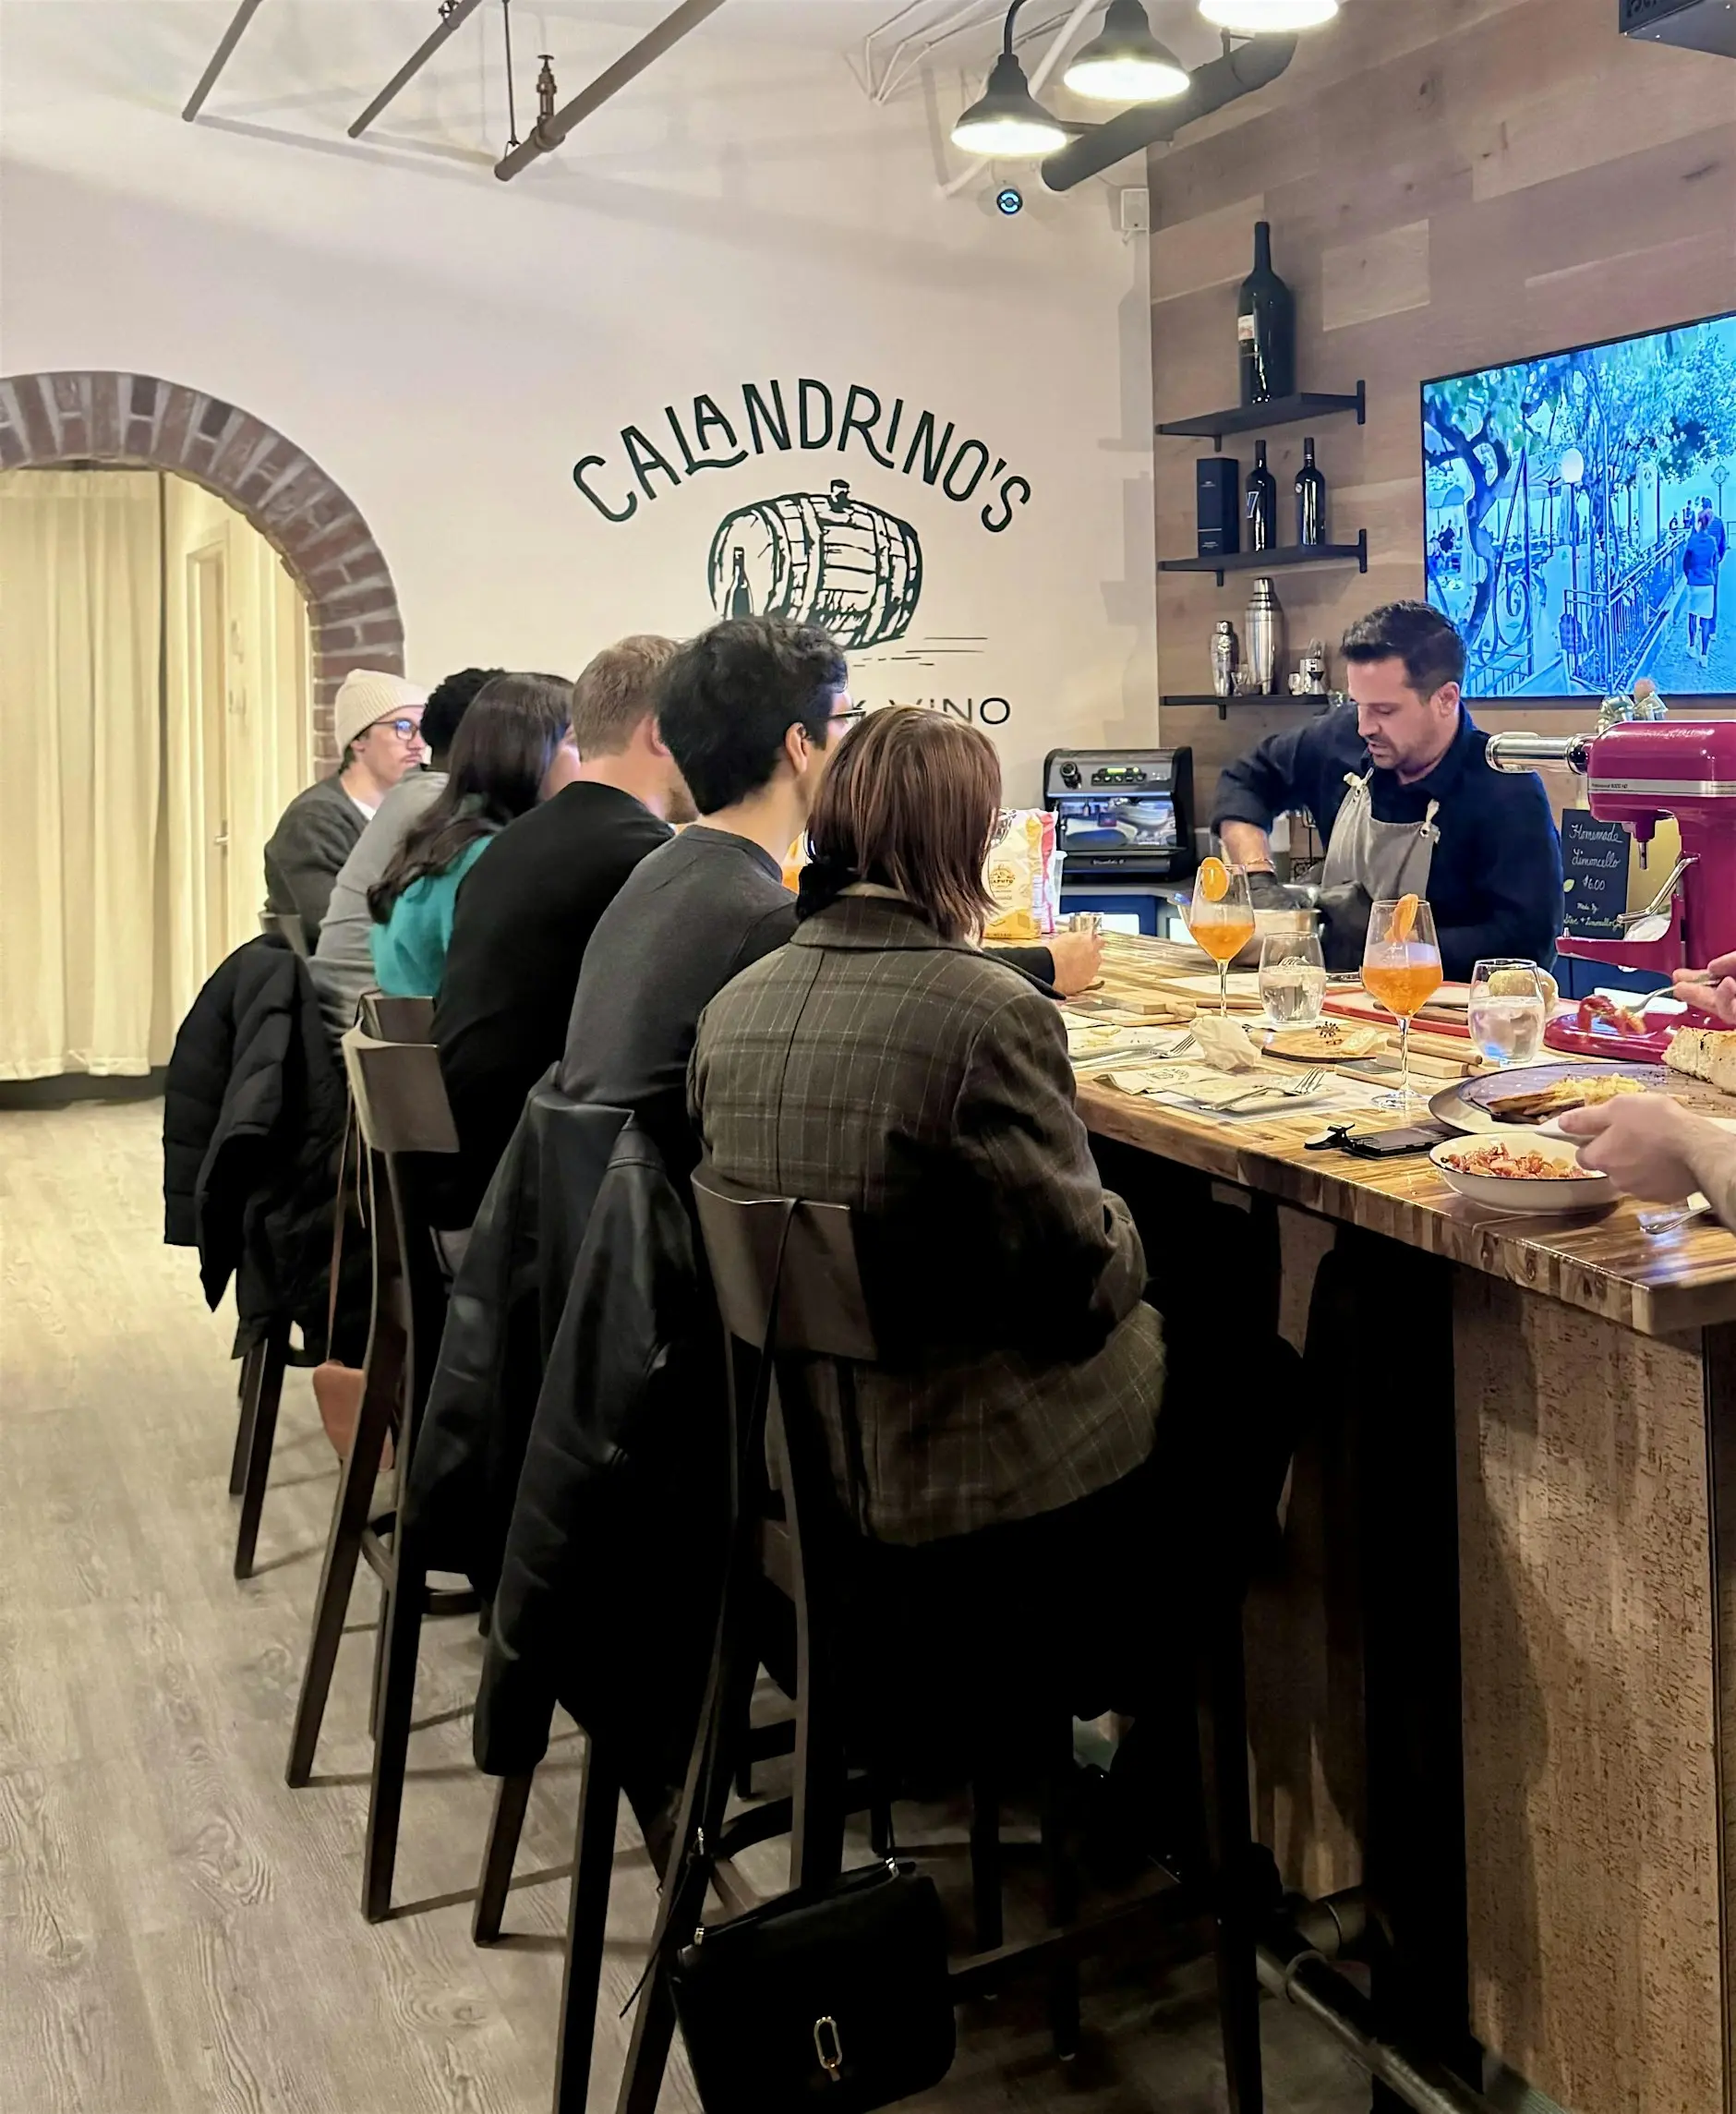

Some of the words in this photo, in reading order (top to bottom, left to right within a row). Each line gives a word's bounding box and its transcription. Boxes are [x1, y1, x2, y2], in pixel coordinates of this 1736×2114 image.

[573, 378, 1031, 533] CALANDRINO'S
[1569, 823, 1623, 843] Homemade
[1572, 848, 1621, 868] Limoncello
